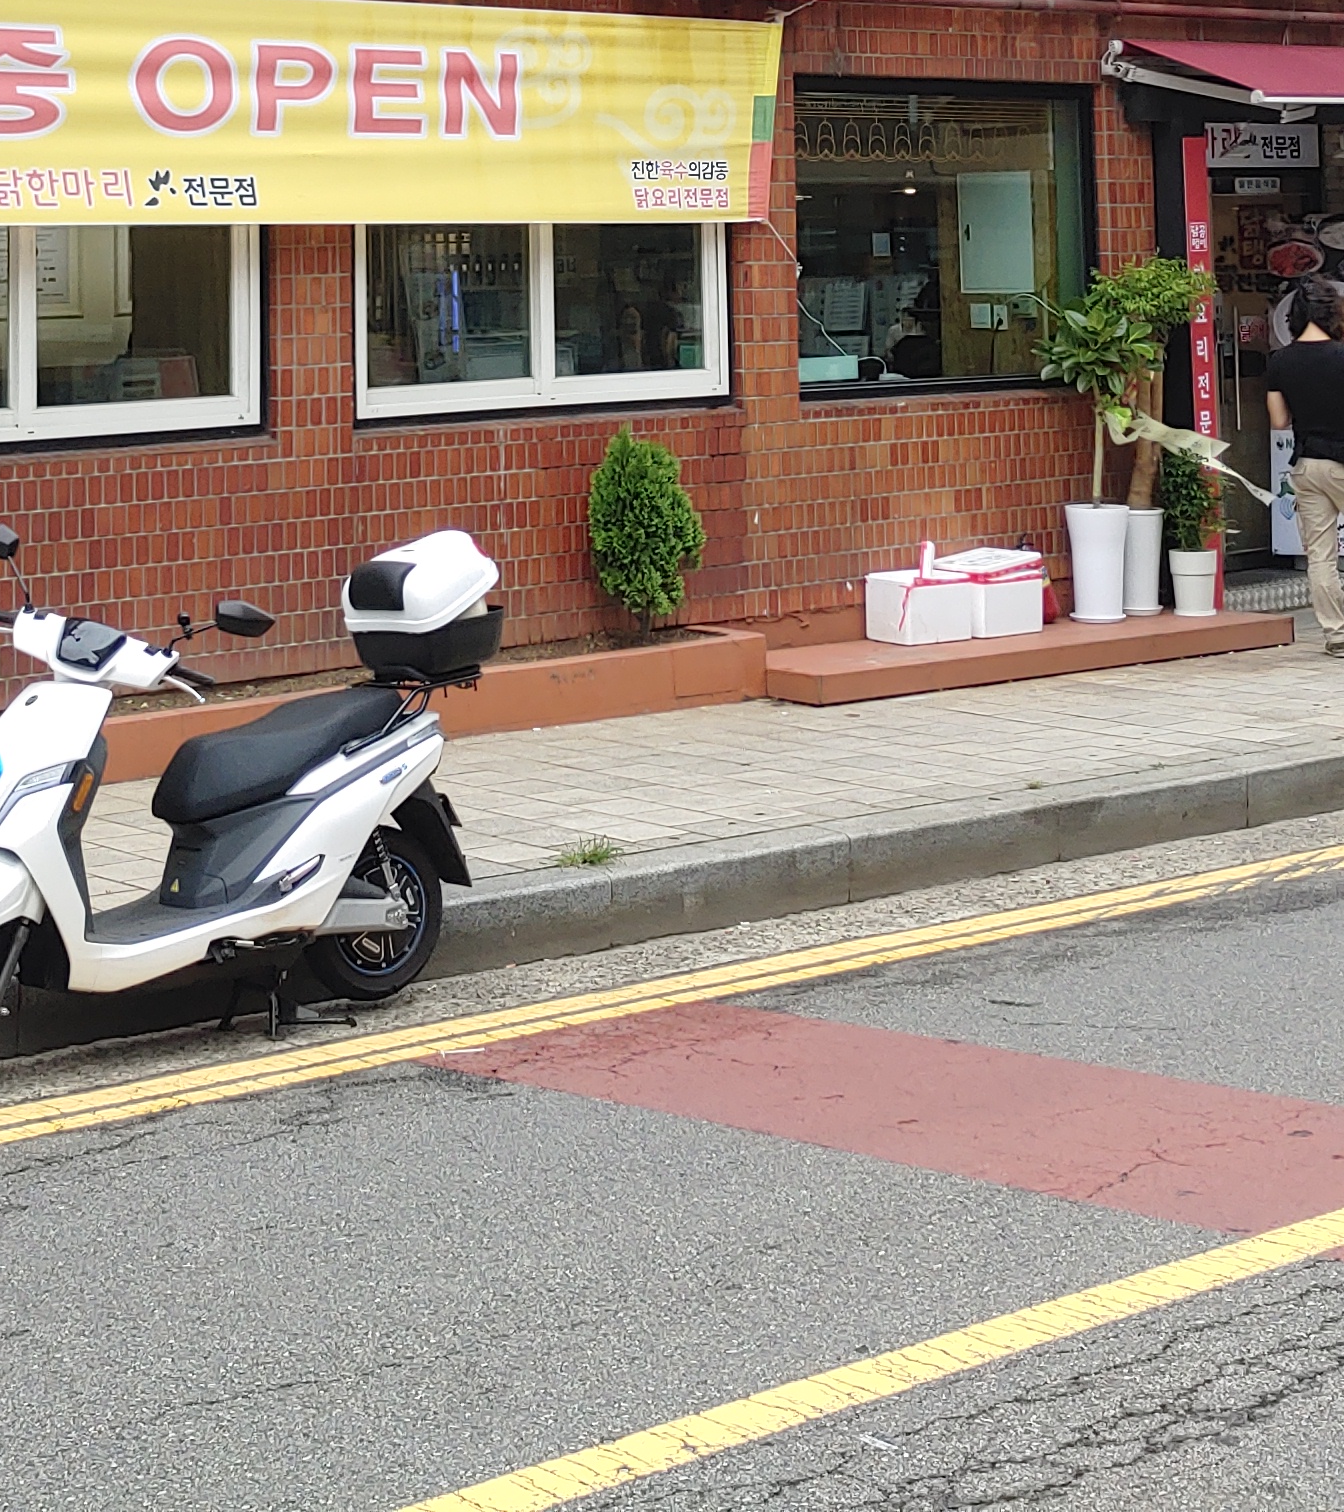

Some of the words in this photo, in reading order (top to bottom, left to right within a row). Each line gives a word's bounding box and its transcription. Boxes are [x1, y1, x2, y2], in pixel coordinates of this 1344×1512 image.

[131, 37, 522, 139] OPEN
[1260, 134, 1302, 160] 전문점
[182, 175, 259, 207] 전문점
[633, 187, 730, 209] 닭요리전문점
